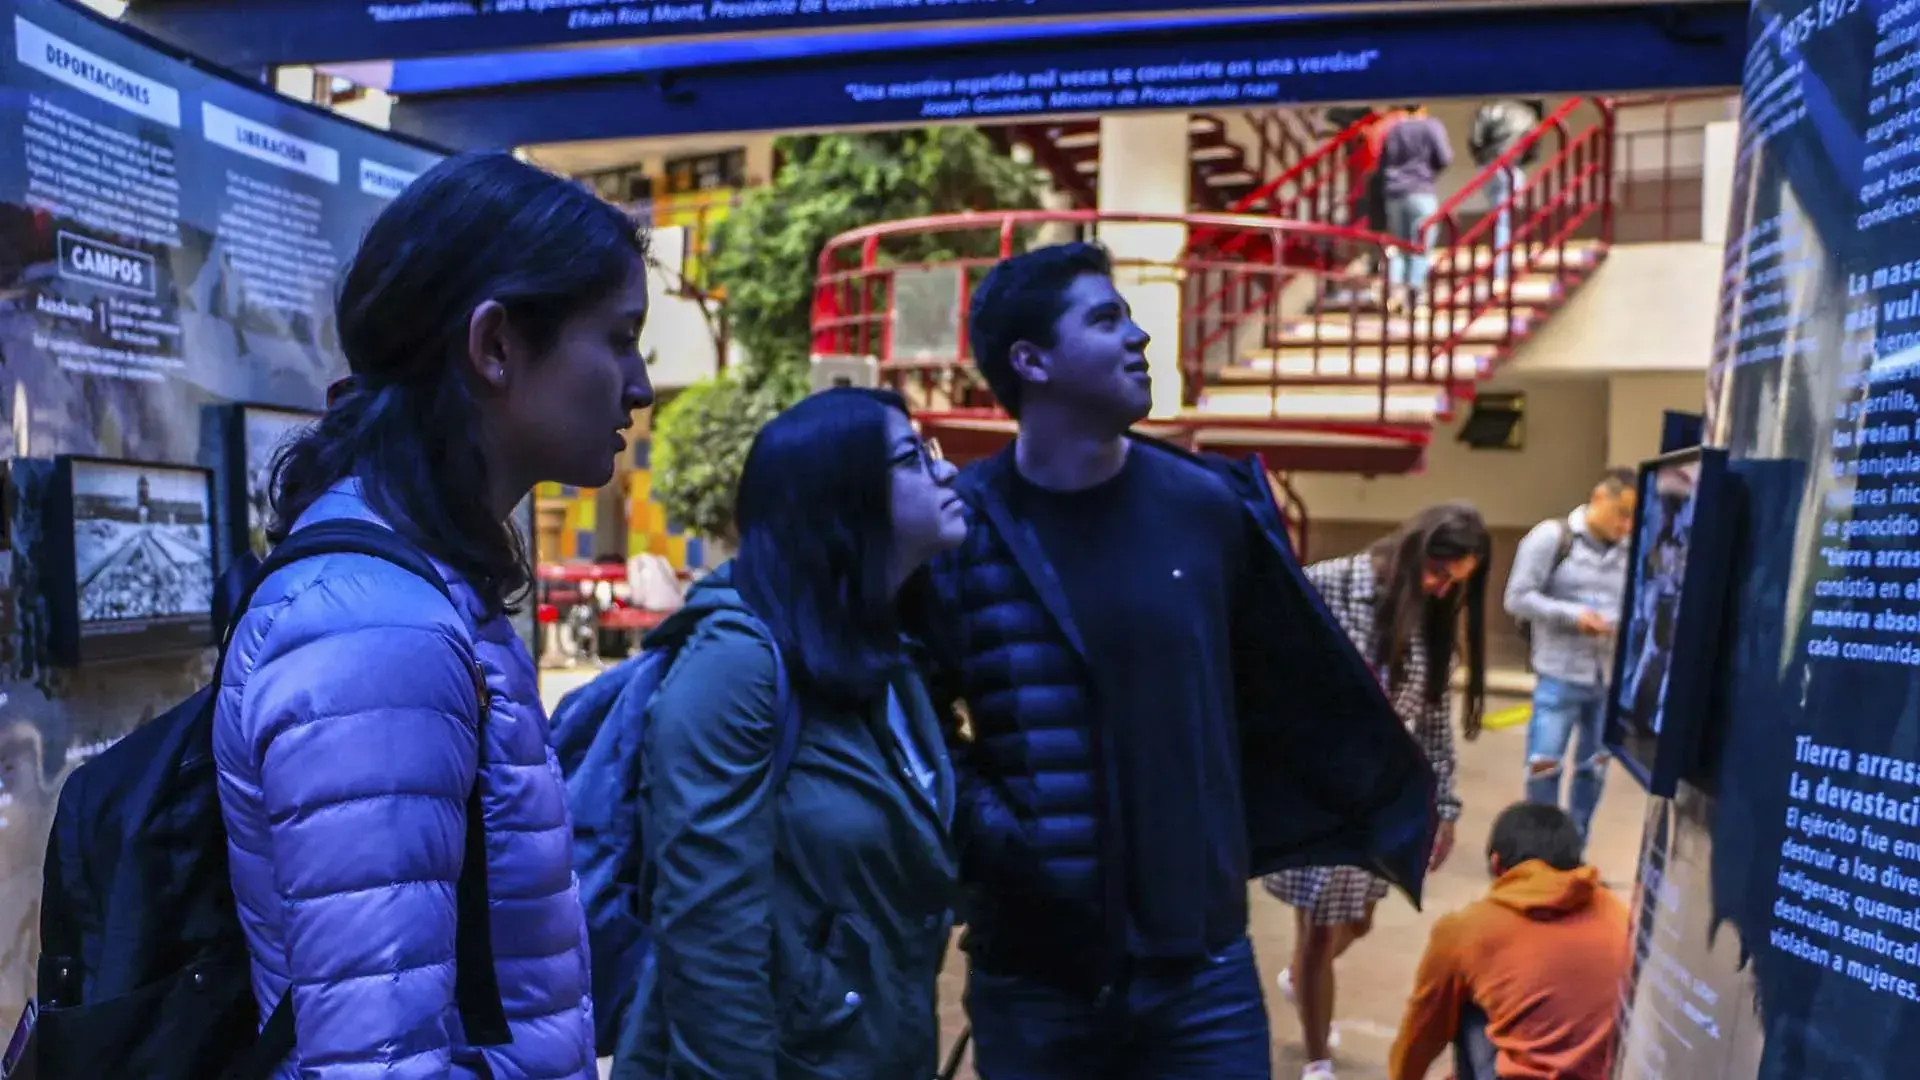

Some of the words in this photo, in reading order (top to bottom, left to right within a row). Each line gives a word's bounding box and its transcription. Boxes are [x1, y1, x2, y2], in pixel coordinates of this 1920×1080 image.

[46, 42, 150, 105] DEPORTACIONES
[888, 80, 951, 98] mentira
[954, 71, 1025, 96] repetida
[1028, 68, 1057, 87] mil
[1059, 69, 1108, 87] veces
[1112, 67, 1133, 84] se
[1136, 59, 1223, 83] convierte
[1226, 60, 1251, 77] en
[1256, 57, 1295, 76] una
[1116, 88, 1137, 105] de
[71, 245, 142, 286] CAMPOS
[1848, 271, 1868, 297] La
[1841, 514, 1919, 542] genocidio
[1879, 581, 1901, 600] en
[1811, 609, 1870, 629] manera
[1807, 634, 1840, 657] cada
[1795, 734, 1852, 773] Tierra
[1789, 770, 1809, 801] La
[1861, 824, 1889, 854] fue
[1781, 835, 1837, 871] destruir
[1838, 857, 1850, 876] a
[1853, 855, 1877, 884] los
[1770, 927, 1829, 968] violaban
[1832, 954, 1843, 973] a
